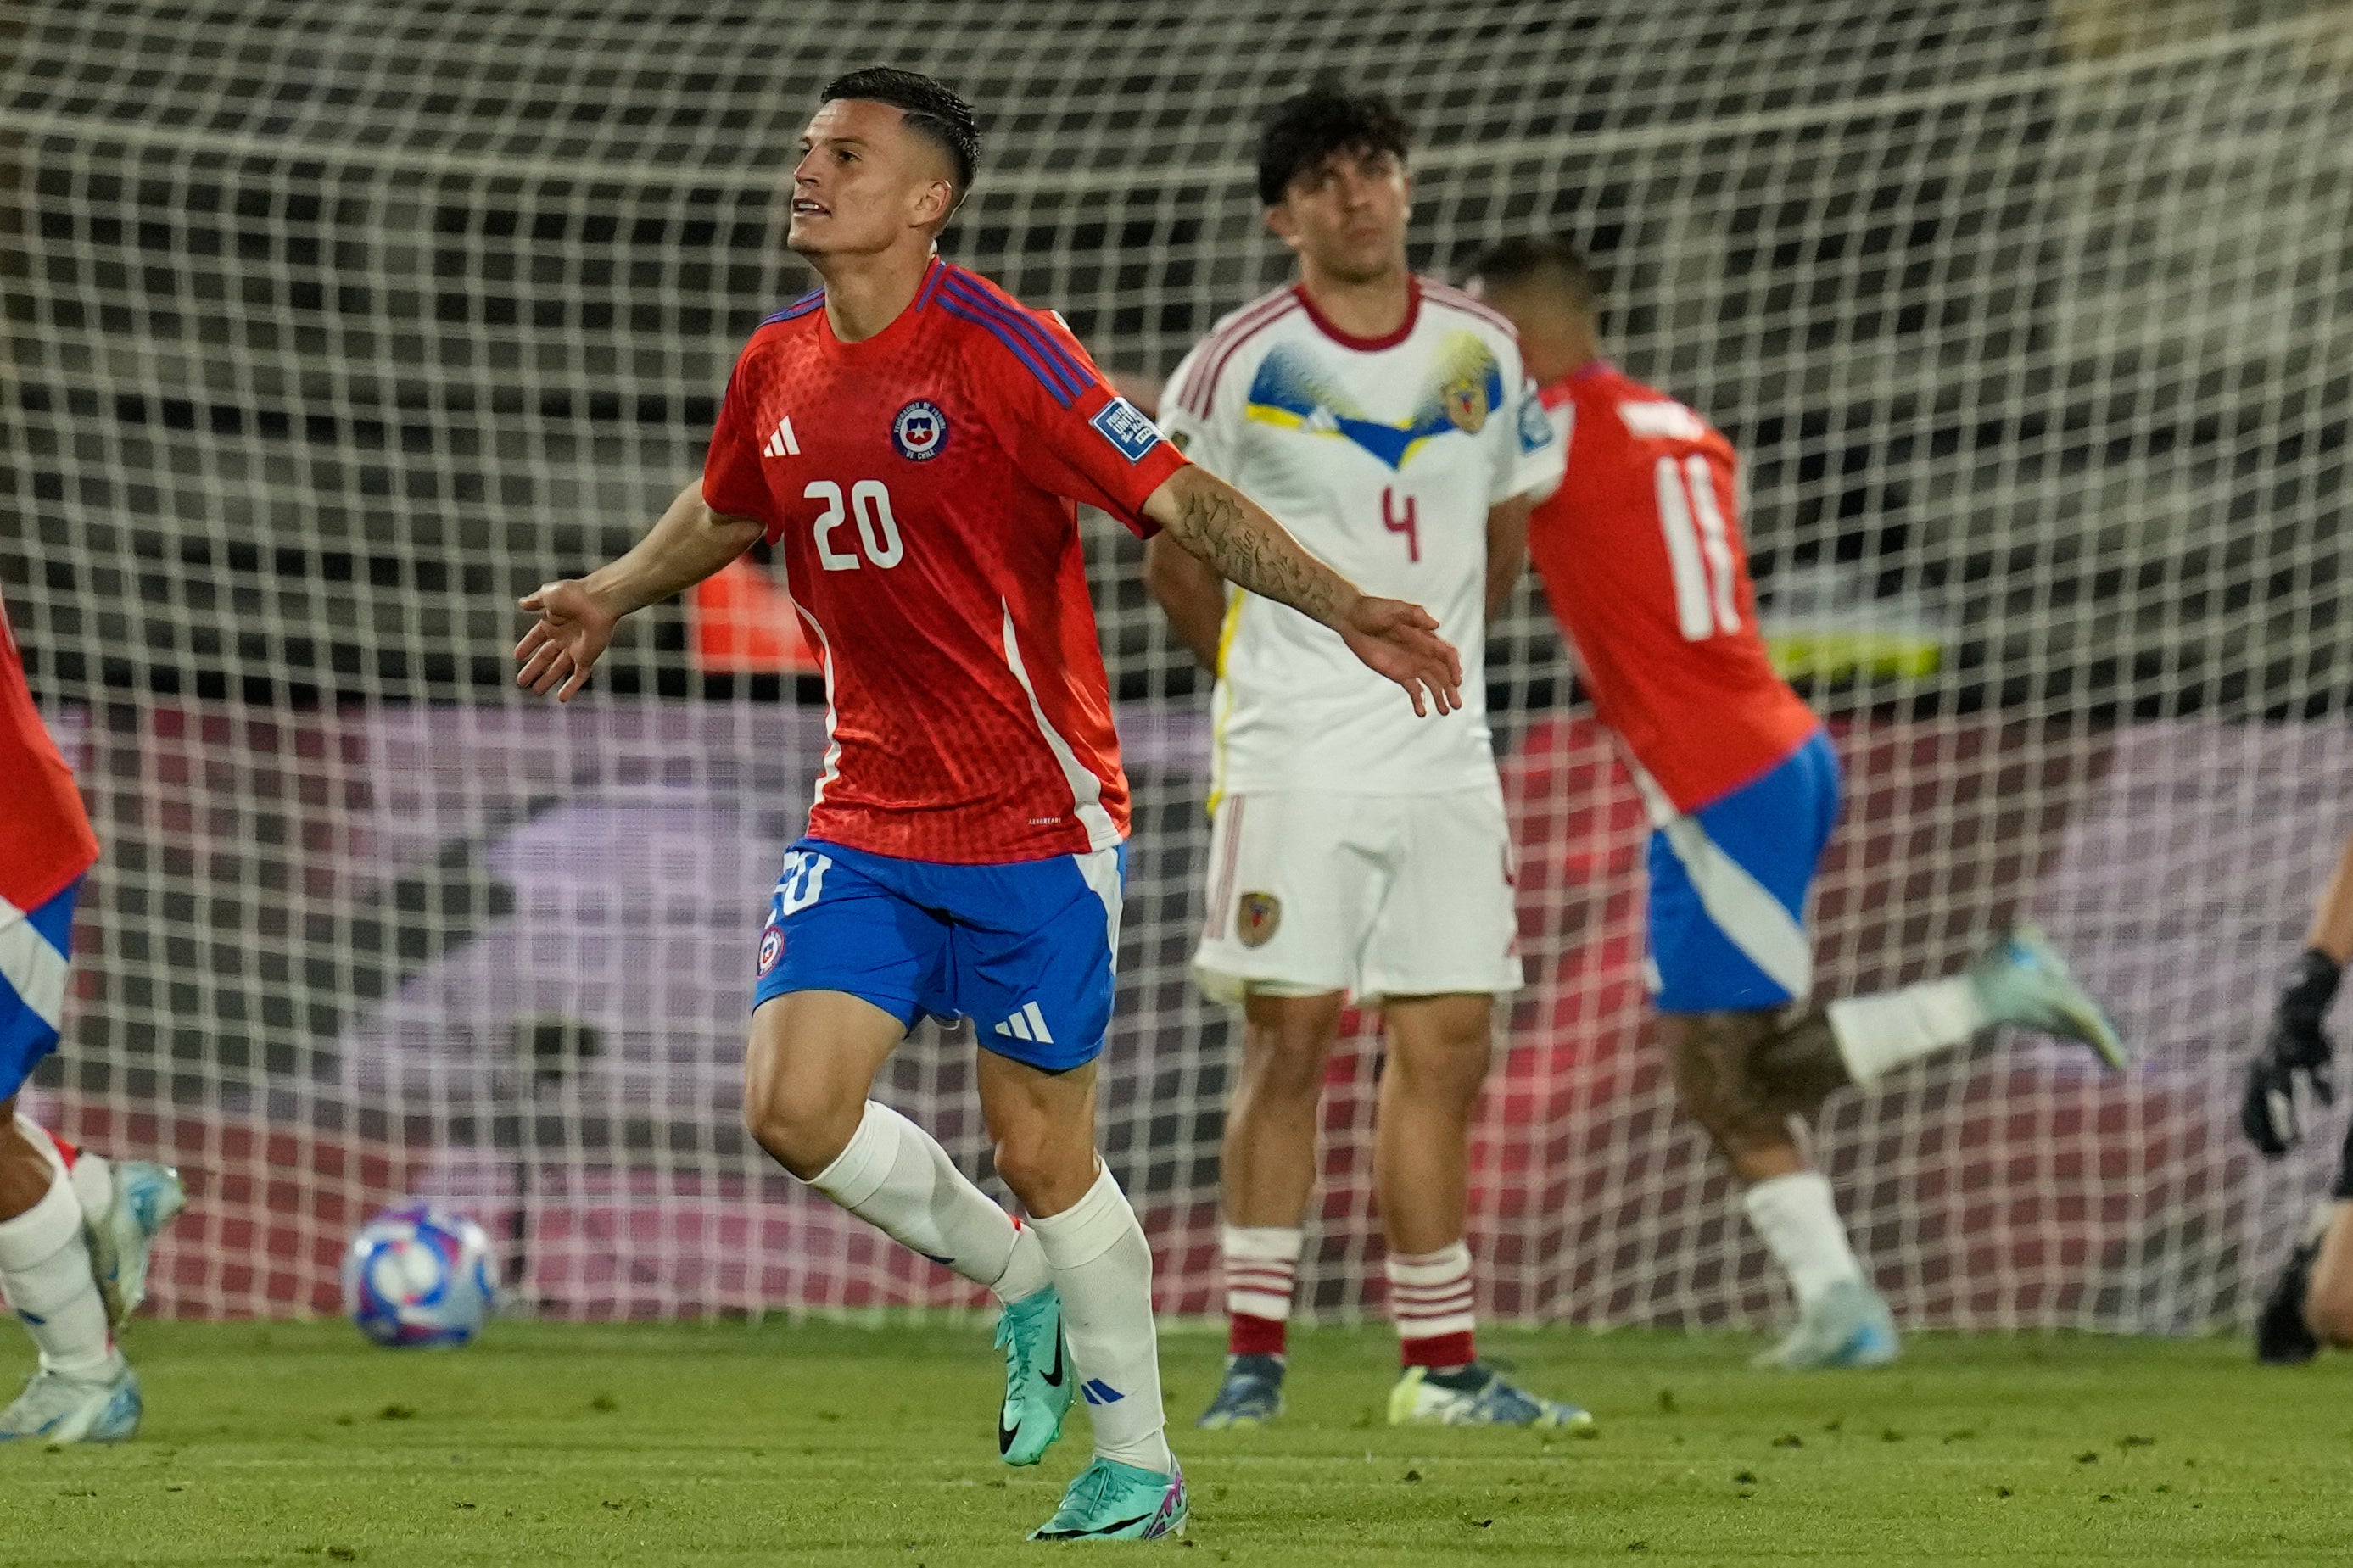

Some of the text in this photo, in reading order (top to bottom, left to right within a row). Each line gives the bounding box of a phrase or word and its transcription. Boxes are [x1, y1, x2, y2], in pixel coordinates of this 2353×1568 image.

[803, 480, 903, 571] 20
[1382, 485, 1420, 563] 4
[1656, 453, 1740, 641] 11
